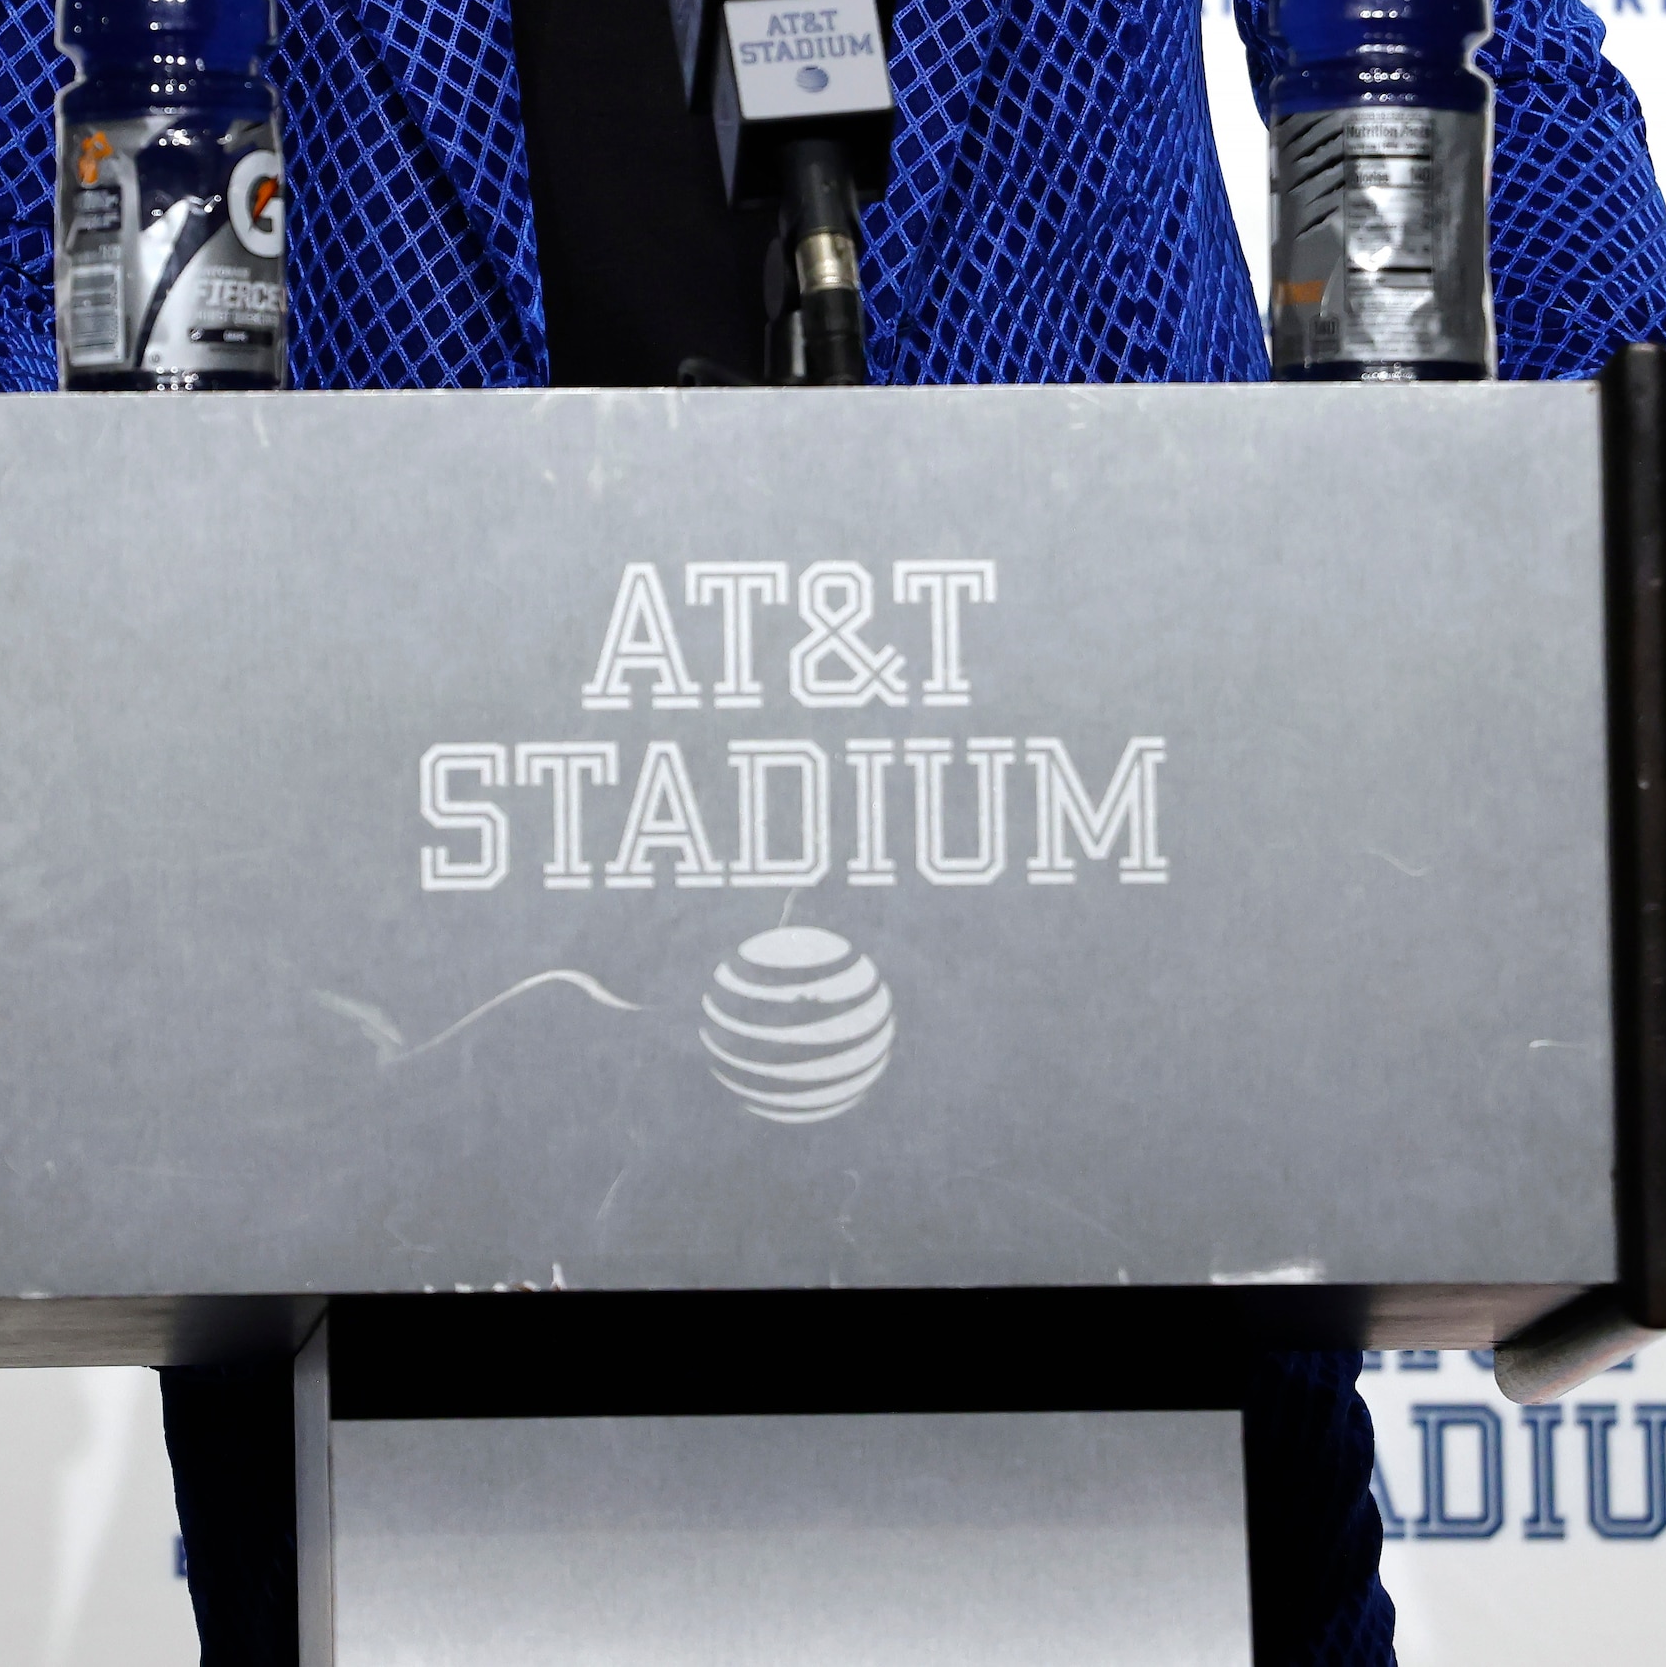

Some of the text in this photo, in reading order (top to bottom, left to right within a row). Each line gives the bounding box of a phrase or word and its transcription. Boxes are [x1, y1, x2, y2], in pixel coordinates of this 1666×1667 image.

[738, 32, 874, 66] STADIUM
[766, 10, 839, 37] AT&T
[227, 149, 284, 258] G
[584, 561, 995, 708] AT&T
[421, 738, 1165, 889] STADIUM
